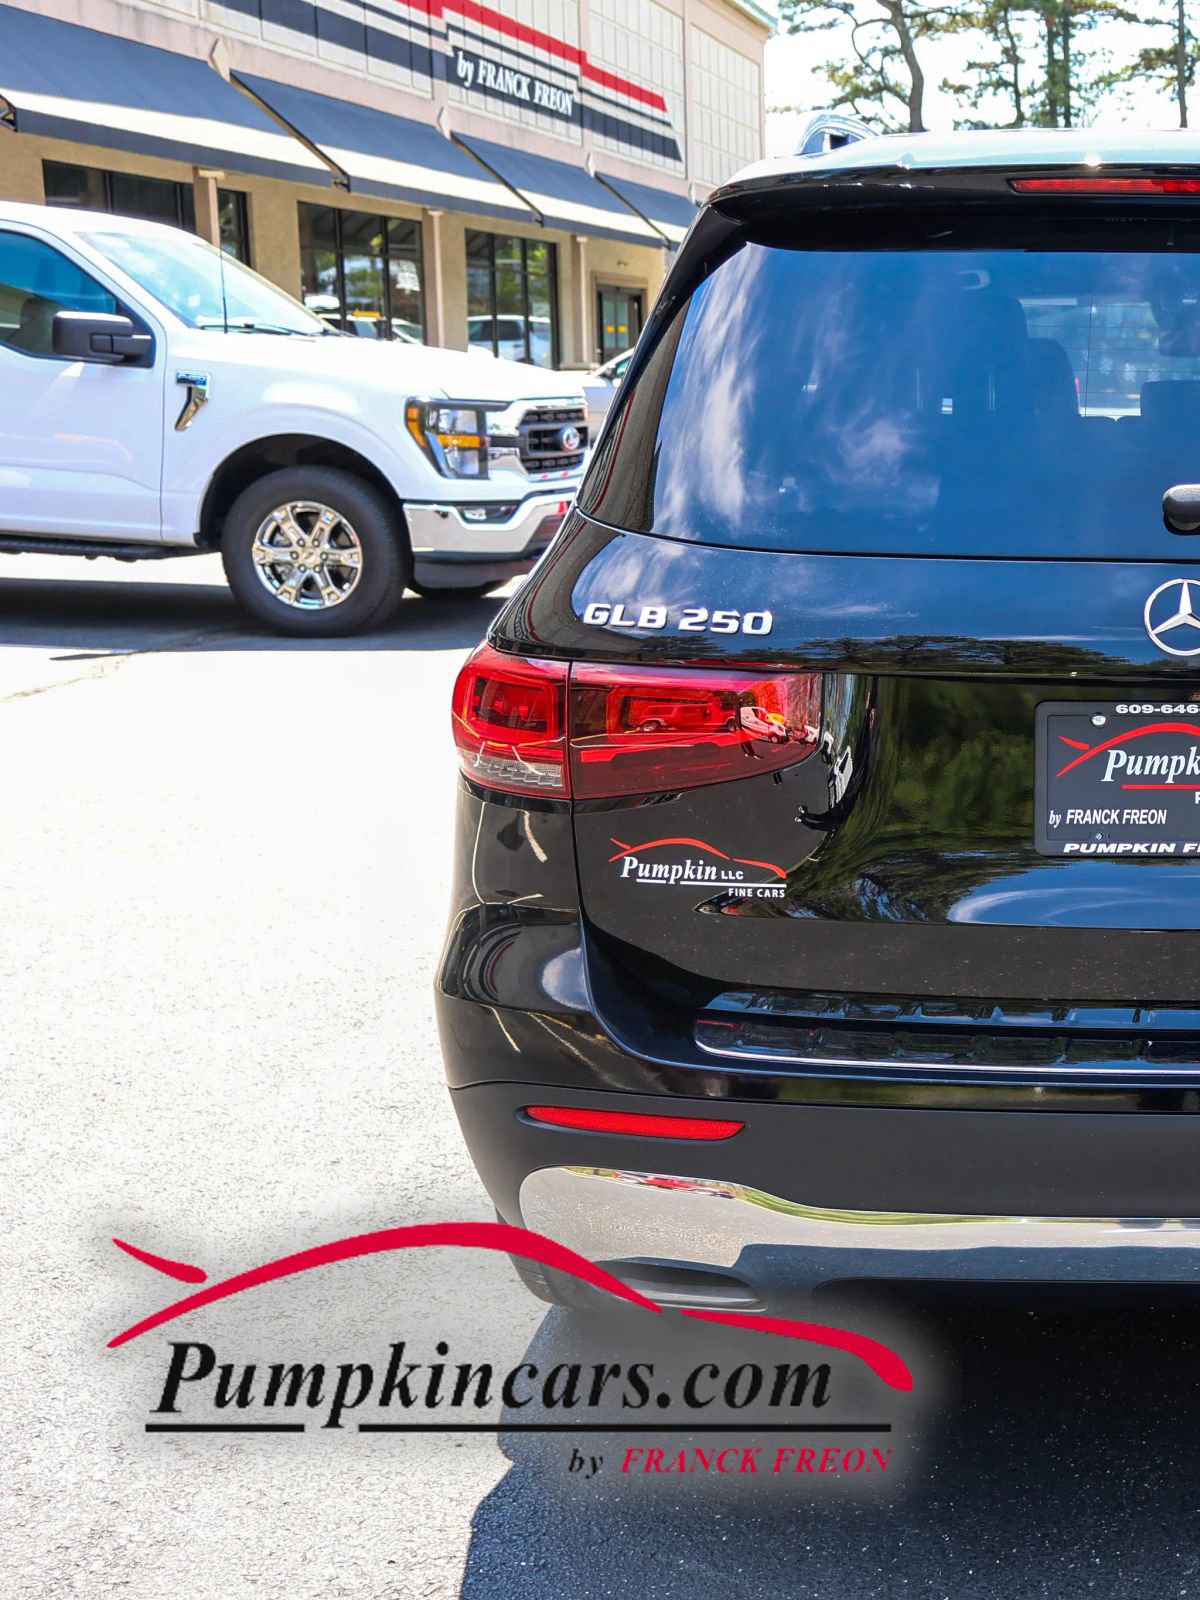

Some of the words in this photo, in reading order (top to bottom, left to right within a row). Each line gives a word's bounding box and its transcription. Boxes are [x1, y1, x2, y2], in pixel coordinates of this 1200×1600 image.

[456, 50, 475, 88] by
[476, 59, 531, 102] FRANCK
[532, 80, 575, 117] FREON
[583, 603, 668, 630] GLB
[678, 607, 773, 635] 250
[1048, 810, 1062, 828] by
[1066, 809, 1120, 825] FRANCK
[1122, 809, 1167, 825] FREON
[1063, 843, 1175, 853] PUMPKIN
[620, 856, 718, 885] Pumpkin
[721, 870, 744, 880] LLC
[728, 888, 753, 898] FINE
[756, 888, 786, 898] CARS
